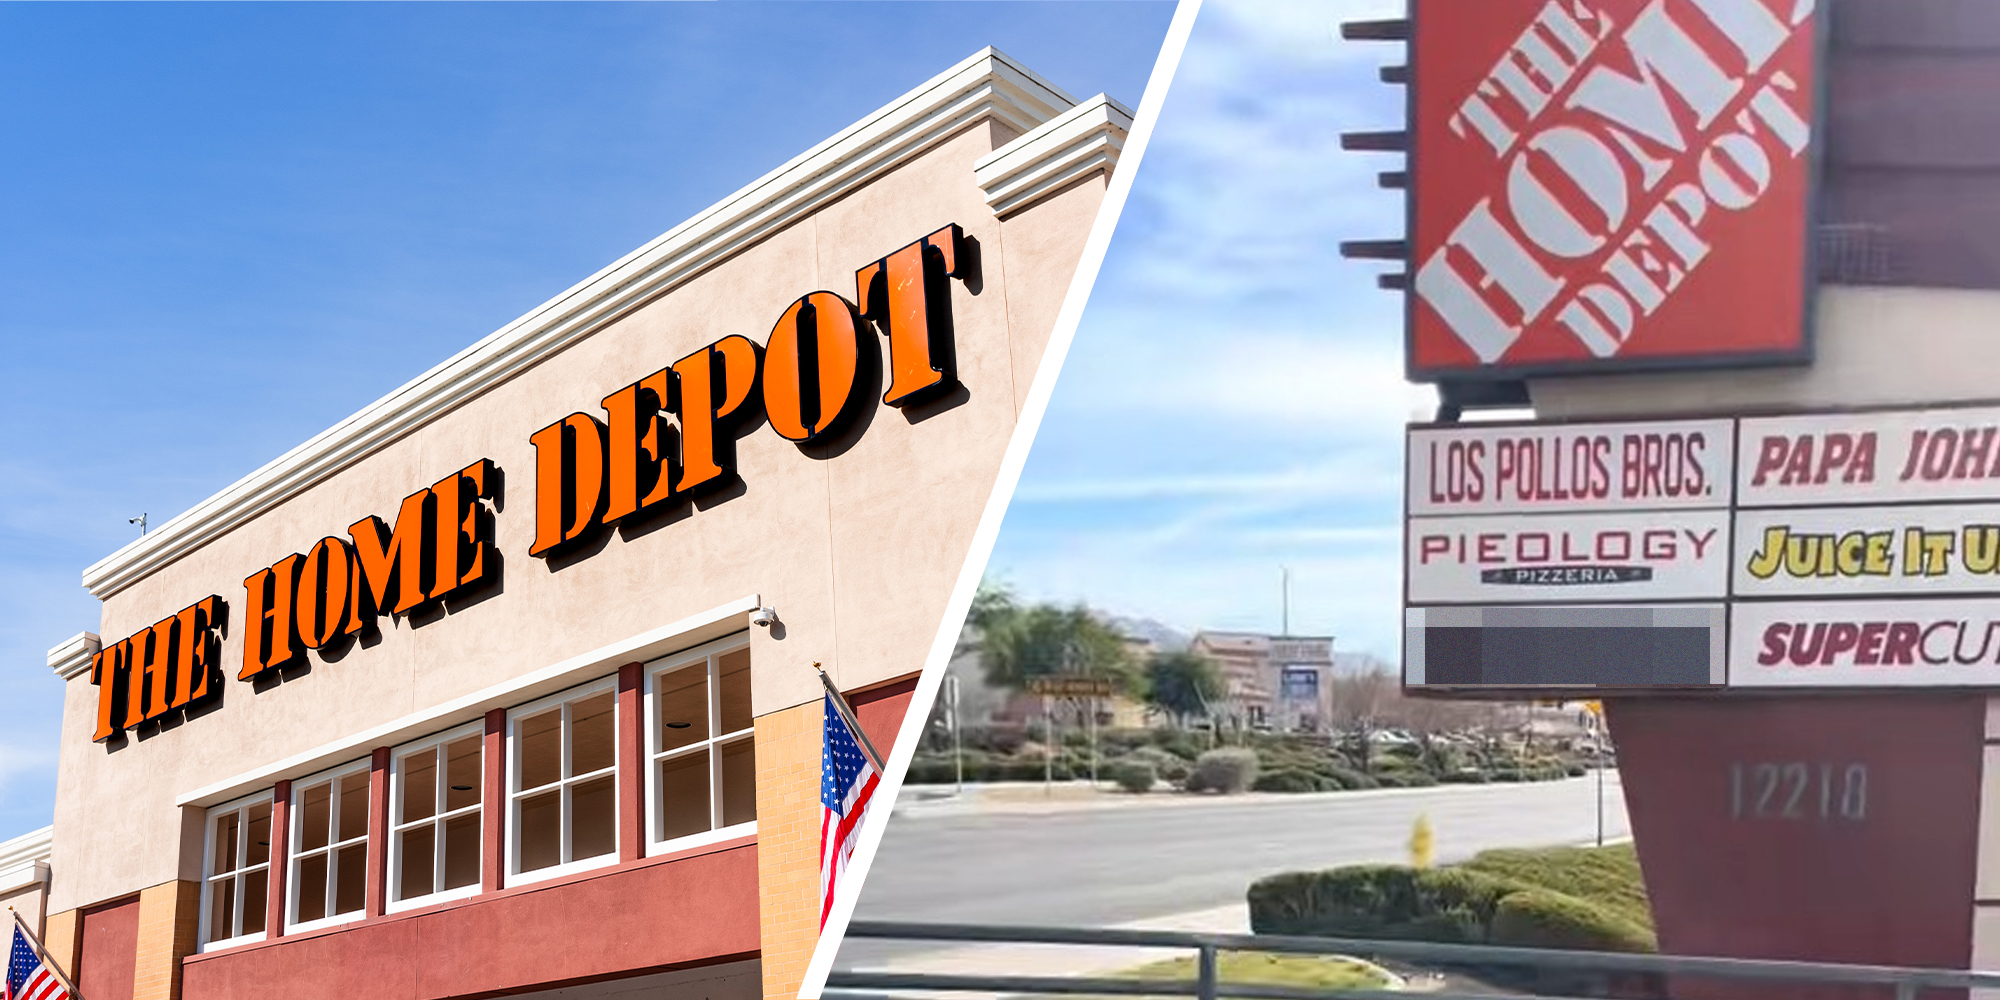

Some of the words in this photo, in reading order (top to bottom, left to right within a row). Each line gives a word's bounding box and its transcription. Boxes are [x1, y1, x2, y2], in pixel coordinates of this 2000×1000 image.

[1448, 0, 1614, 159] THE
[1555, 71, 1810, 358] DEPOT
[91, 594, 223, 743] THE
[239, 457, 493, 682] HOME
[529, 222, 962, 559] DEPOT
[1429, 440, 1485, 503] LOS
[1496, 436, 1612, 500] POLLOS
[1622, 432, 1712, 498] BROS.
[1751, 433, 1877, 487] PAPA
[1899, 427, 2000, 482] JOH
[1420, 528, 1718, 564] PIEOLOGY
[1516, 567, 1619, 582] PIZZERIA
[1747, 525, 1894, 579] JUICE
[1903, 526, 1956, 576] IT
[1963, 524, 2000, 574] U
